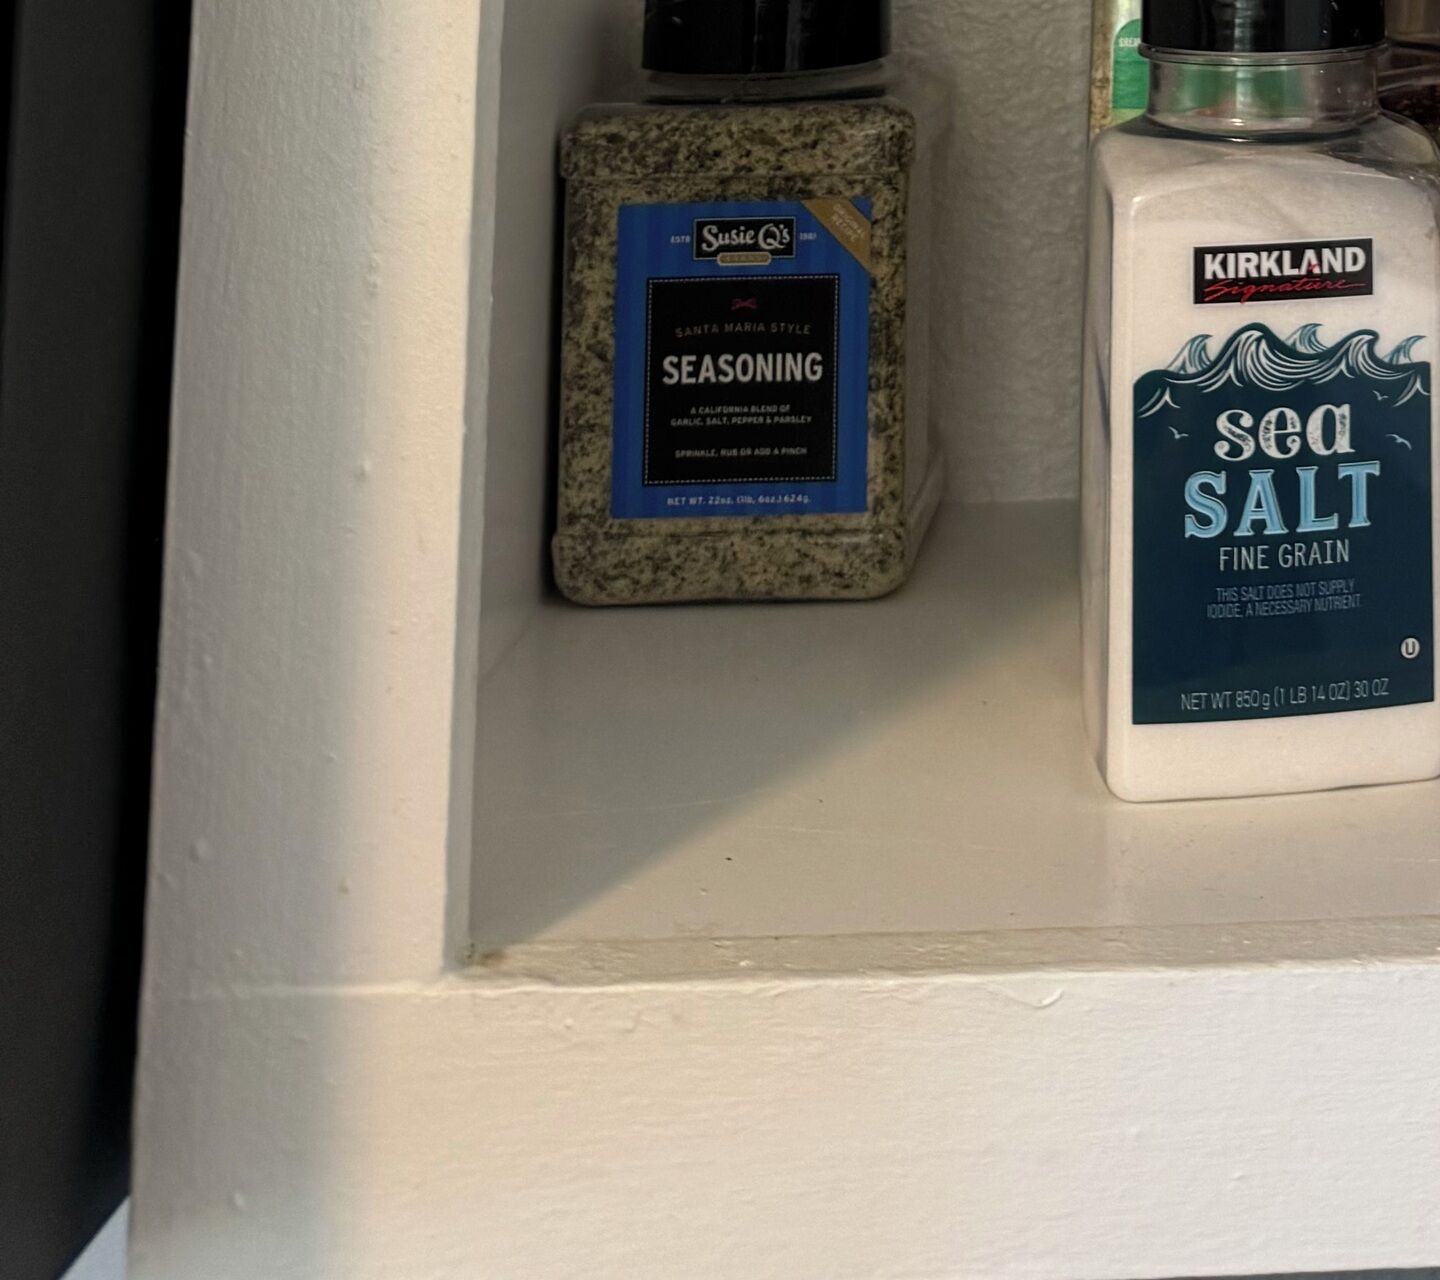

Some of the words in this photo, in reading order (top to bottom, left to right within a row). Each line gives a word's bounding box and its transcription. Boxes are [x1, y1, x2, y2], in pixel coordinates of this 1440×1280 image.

[702, 225, 756, 253] Susie
[1203, 246, 1367, 280] KIRKLAND
[1203, 278, 1368, 304] Signature
[675, 323, 720, 339] SANTA
[723, 321, 767, 334] MARIA
[770, 321, 813, 336] STYLE
[661, 351, 824, 385] SEASONING
[1213, 402, 1356, 462] sea
[1183, 459, 1382, 540] SALT
[1218, 545, 1270, 572] FINE
[1278, 539, 1350, 569] GRAIN
[1216, 586, 1239, 602] THIS
[1240, 585, 1264, 601] SALT
[1266, 583, 1294, 600] DOES
[1295, 582, 1317, 598] NOT
[1318, 578, 1356, 596] SUPPLY
[1245, 602, 1255, 618] A
[1255, 597, 1313, 617] NECESSARY
[1181, 692, 1209, 711] NET
[1210, 691, 1232, 710] WT
[1274, 685, 1285, 707] (1
[1290, 686, 1307, 704] LB
[1311, 684, 1326, 702] 14
[1328, 679, 1350, 701] OZ)
[1353, 680, 1369, 699] 30
[1371, 678, 1390, 697] OZ
